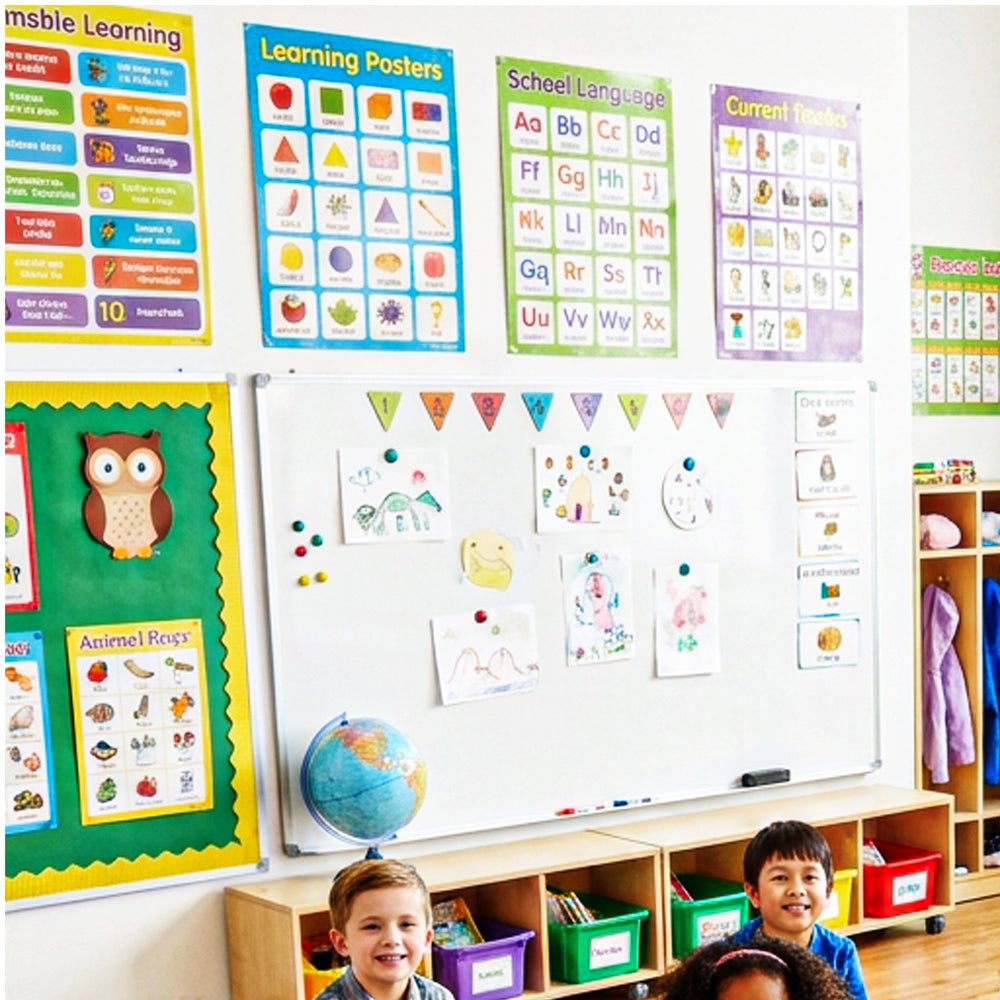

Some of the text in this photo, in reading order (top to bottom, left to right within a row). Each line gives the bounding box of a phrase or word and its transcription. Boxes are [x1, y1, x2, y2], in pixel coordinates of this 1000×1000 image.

[260, 37, 442, 80] Learning Posters
[507, 69, 571, 95] Scheel
[725, 94, 789, 121] Current
[514, 111, 542, 134] Aa
[557, 114, 582, 137] Bb
[636, 124, 661, 145] Dd
[520, 160, 540, 181] Ff
[557, 164, 585, 192] Gg
[597, 168, 624, 189] Hh
[639, 218, 665, 239] Nn
[564, 261, 586, 281] Rr
[603, 263, 626, 284] Ss
[99, 300, 126, 323] 10
[522, 306, 550, 328] Uu
[563, 308, 589, 329] Vv
